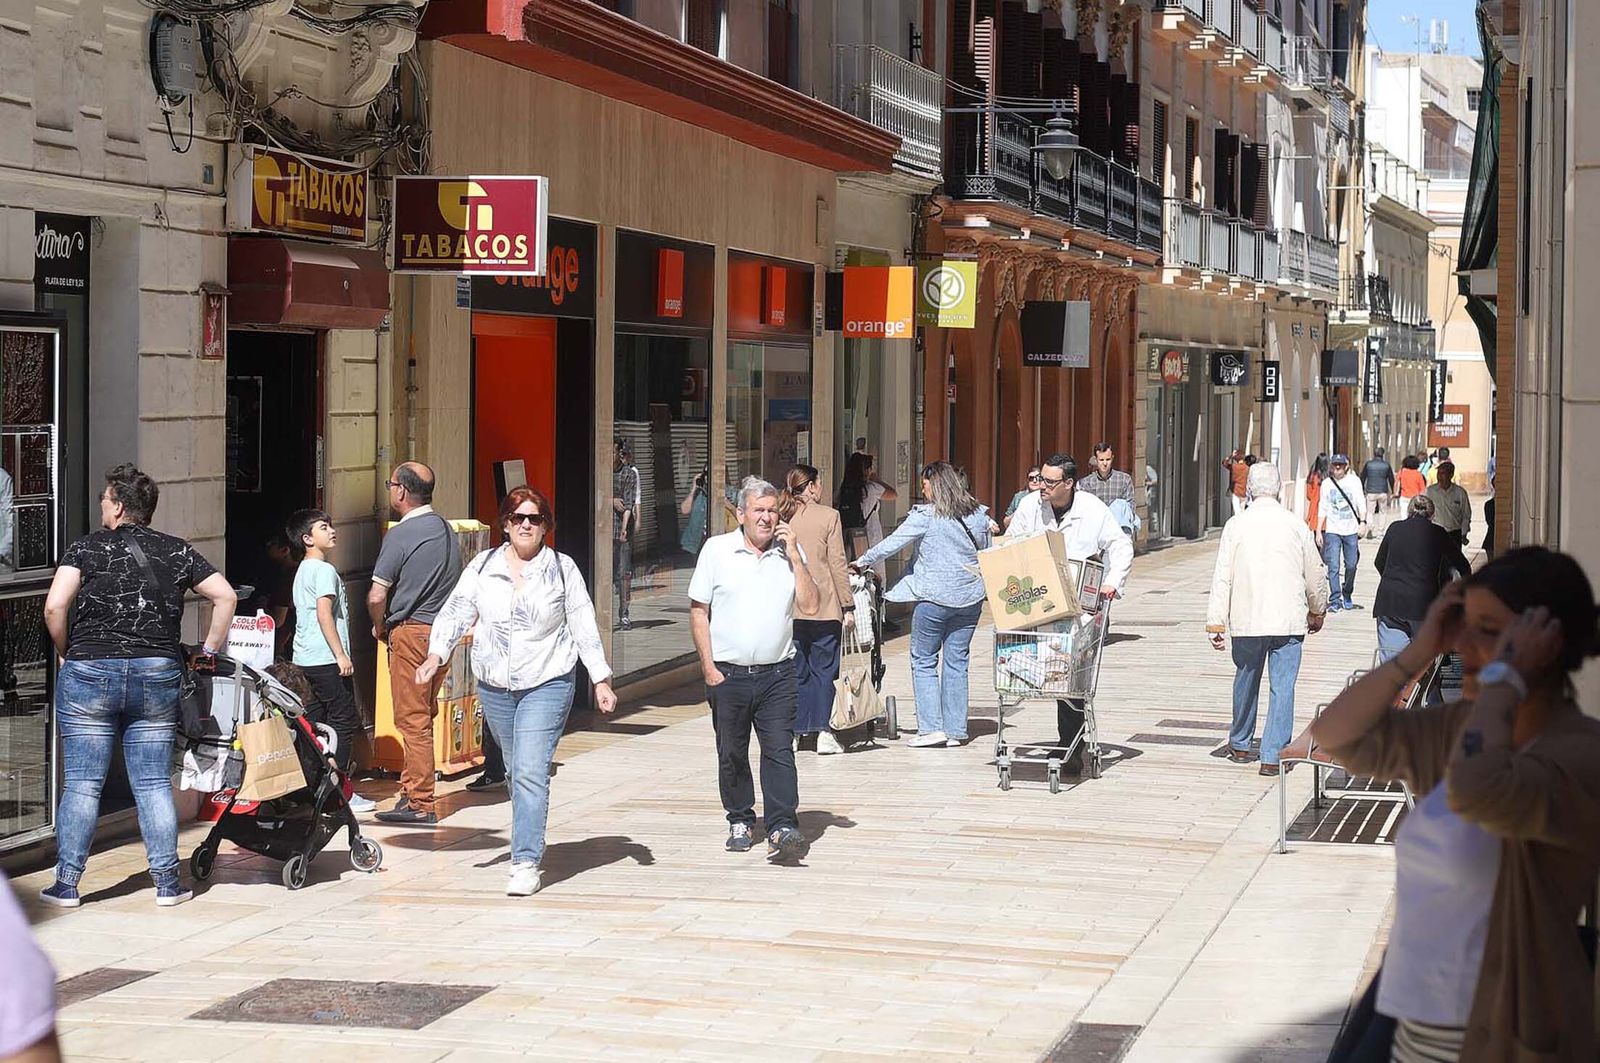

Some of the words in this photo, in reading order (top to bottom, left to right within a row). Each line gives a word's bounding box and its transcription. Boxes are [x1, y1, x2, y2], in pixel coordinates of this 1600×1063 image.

[288, 162, 364, 218] TABACOS
[402, 234, 528, 258] TABACOS
[59, 277, 66, 286] DE
[846, 320, 906, 336] orange
[1008, 585, 1048, 606] sanblas
[231, 623, 256, 631] RINKS
[236, 617, 257, 625] COLD
[228, 640, 244, 648] TAKE
[244, 641, 264, 649] AWAY
